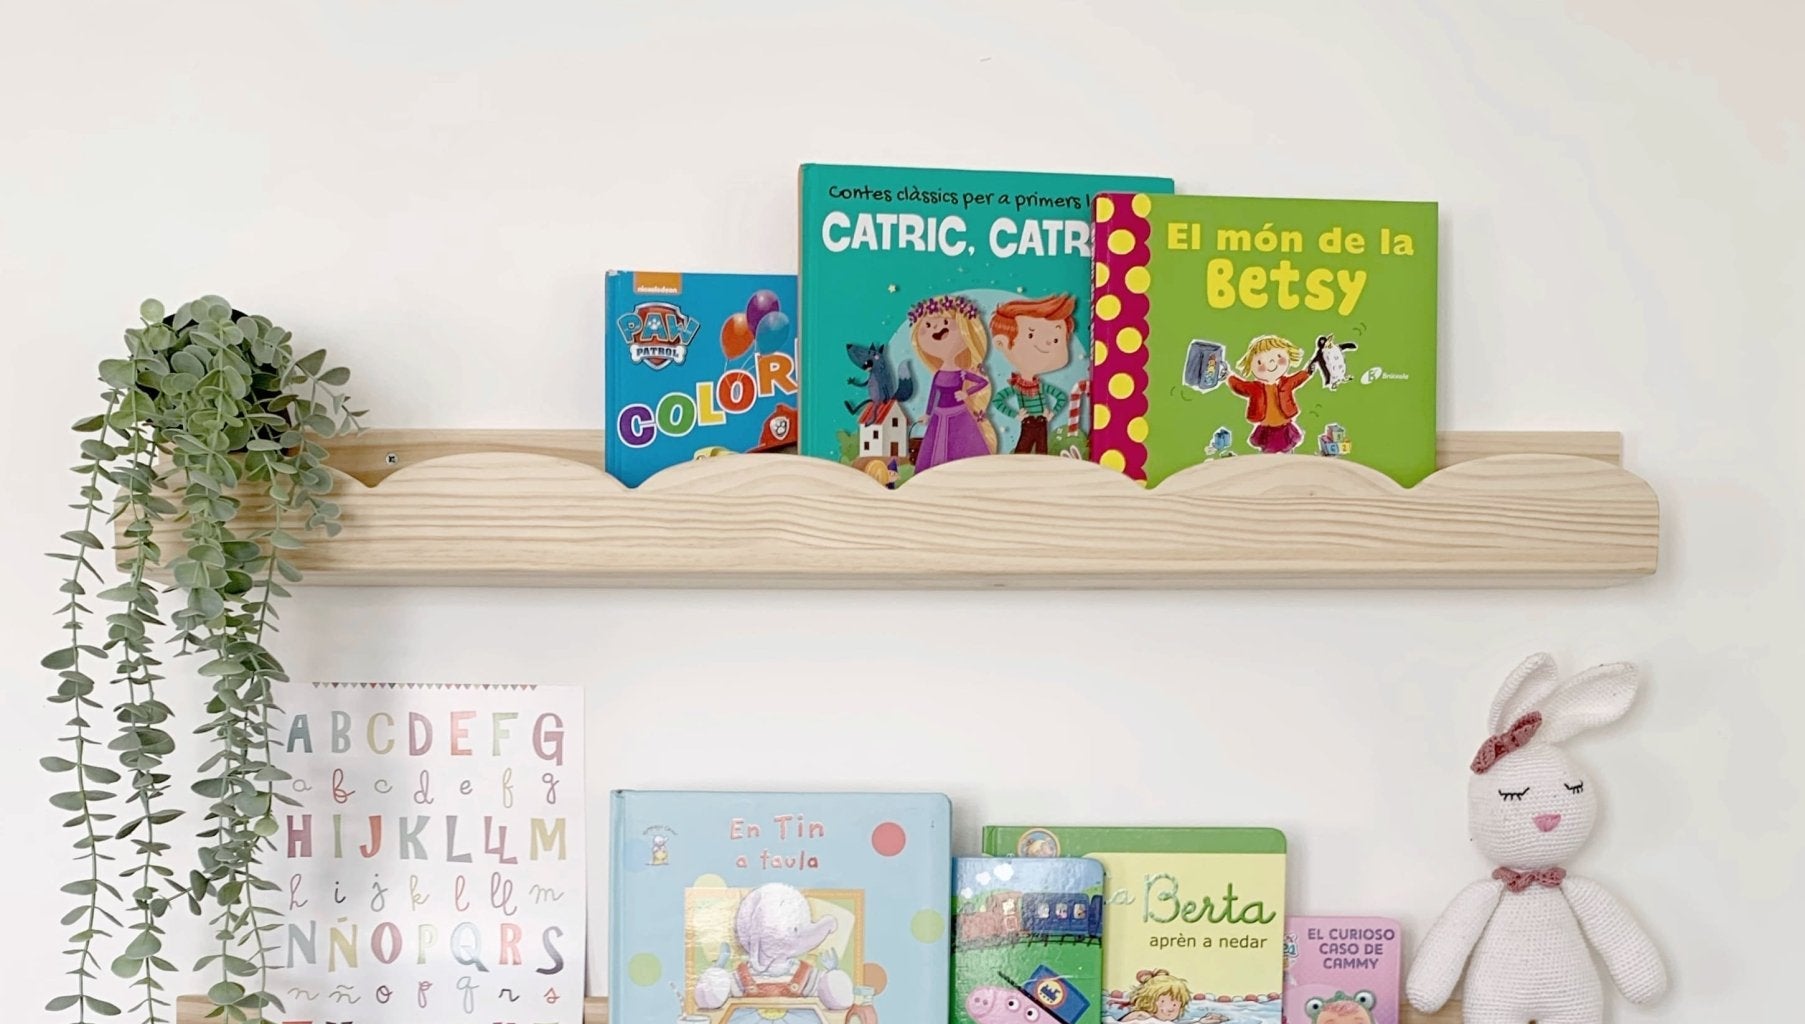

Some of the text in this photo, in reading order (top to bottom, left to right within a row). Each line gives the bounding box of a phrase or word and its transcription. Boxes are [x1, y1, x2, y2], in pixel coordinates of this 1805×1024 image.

[829, 185, 892, 202] Contes
[897, 185, 959, 205] clàssics
[963, 191, 995, 210] per
[998, 193, 1010, 204] a
[1015, 192, 1081, 211] primers
[822, 211, 975, 257] CATRIC,
[1167, 223, 1414, 256] El món de la
[1207, 258, 1367, 316] Betsy
[617, 312, 700, 345] PAW
[636, 347, 679, 358] PATROL
[617, 340, 798, 449] COLOR
[287, 711, 564, 766] A B C D E F G
[292, 768, 559, 808] a b c d e f g
[287, 814, 312, 858] H
[332, 814, 343, 858] I
[359, 815, 382, 858] J
[399, 815, 430, 860] K
[446, 815, 473, 863] L
[530, 818, 566, 860] M
[730, 812, 824, 840] En Tin
[736, 849, 818, 870] a taula
[334, 881, 346, 904] i
[370, 873, 388, 912] j
[455, 875, 470, 911] l
[529, 884, 564, 904] m
[1143, 873, 1276, 924] Berta
[286, 917, 564, 975] N Ñ O P Q R S
[1149, 933, 1267, 950] aprèn a nedar
[1308, 928, 1395, 940] EL CURIOSO
[1319, 943, 1383, 955] CASO DE
[1323, 957, 1379, 969] CAMMY
[328, 985, 361, 1004] ñ
[376, 985, 393, 1004] o
